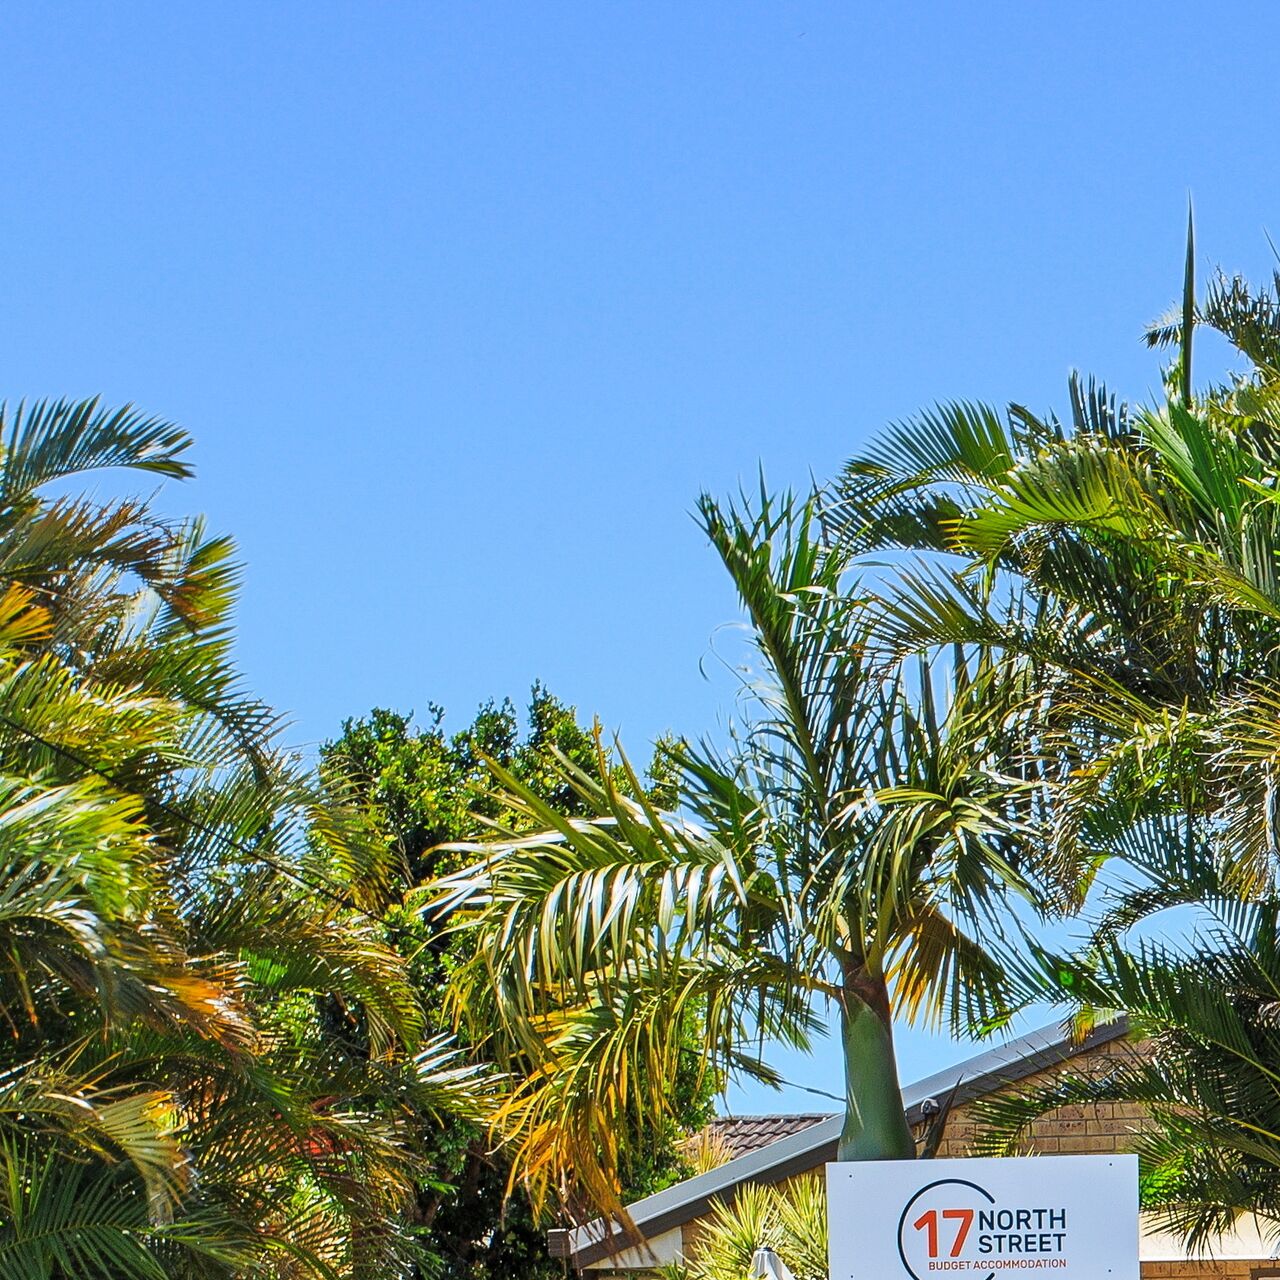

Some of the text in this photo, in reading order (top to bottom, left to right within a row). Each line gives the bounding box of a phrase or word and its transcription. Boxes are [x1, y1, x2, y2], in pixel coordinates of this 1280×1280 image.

[978, 1208, 1067, 1231] NORTH
[913, 1209, 974, 1258] 17
[978, 1233, 1067, 1254] STREET
[928, 1258, 1067, 1271] BUDGET ACCOMMODATION
